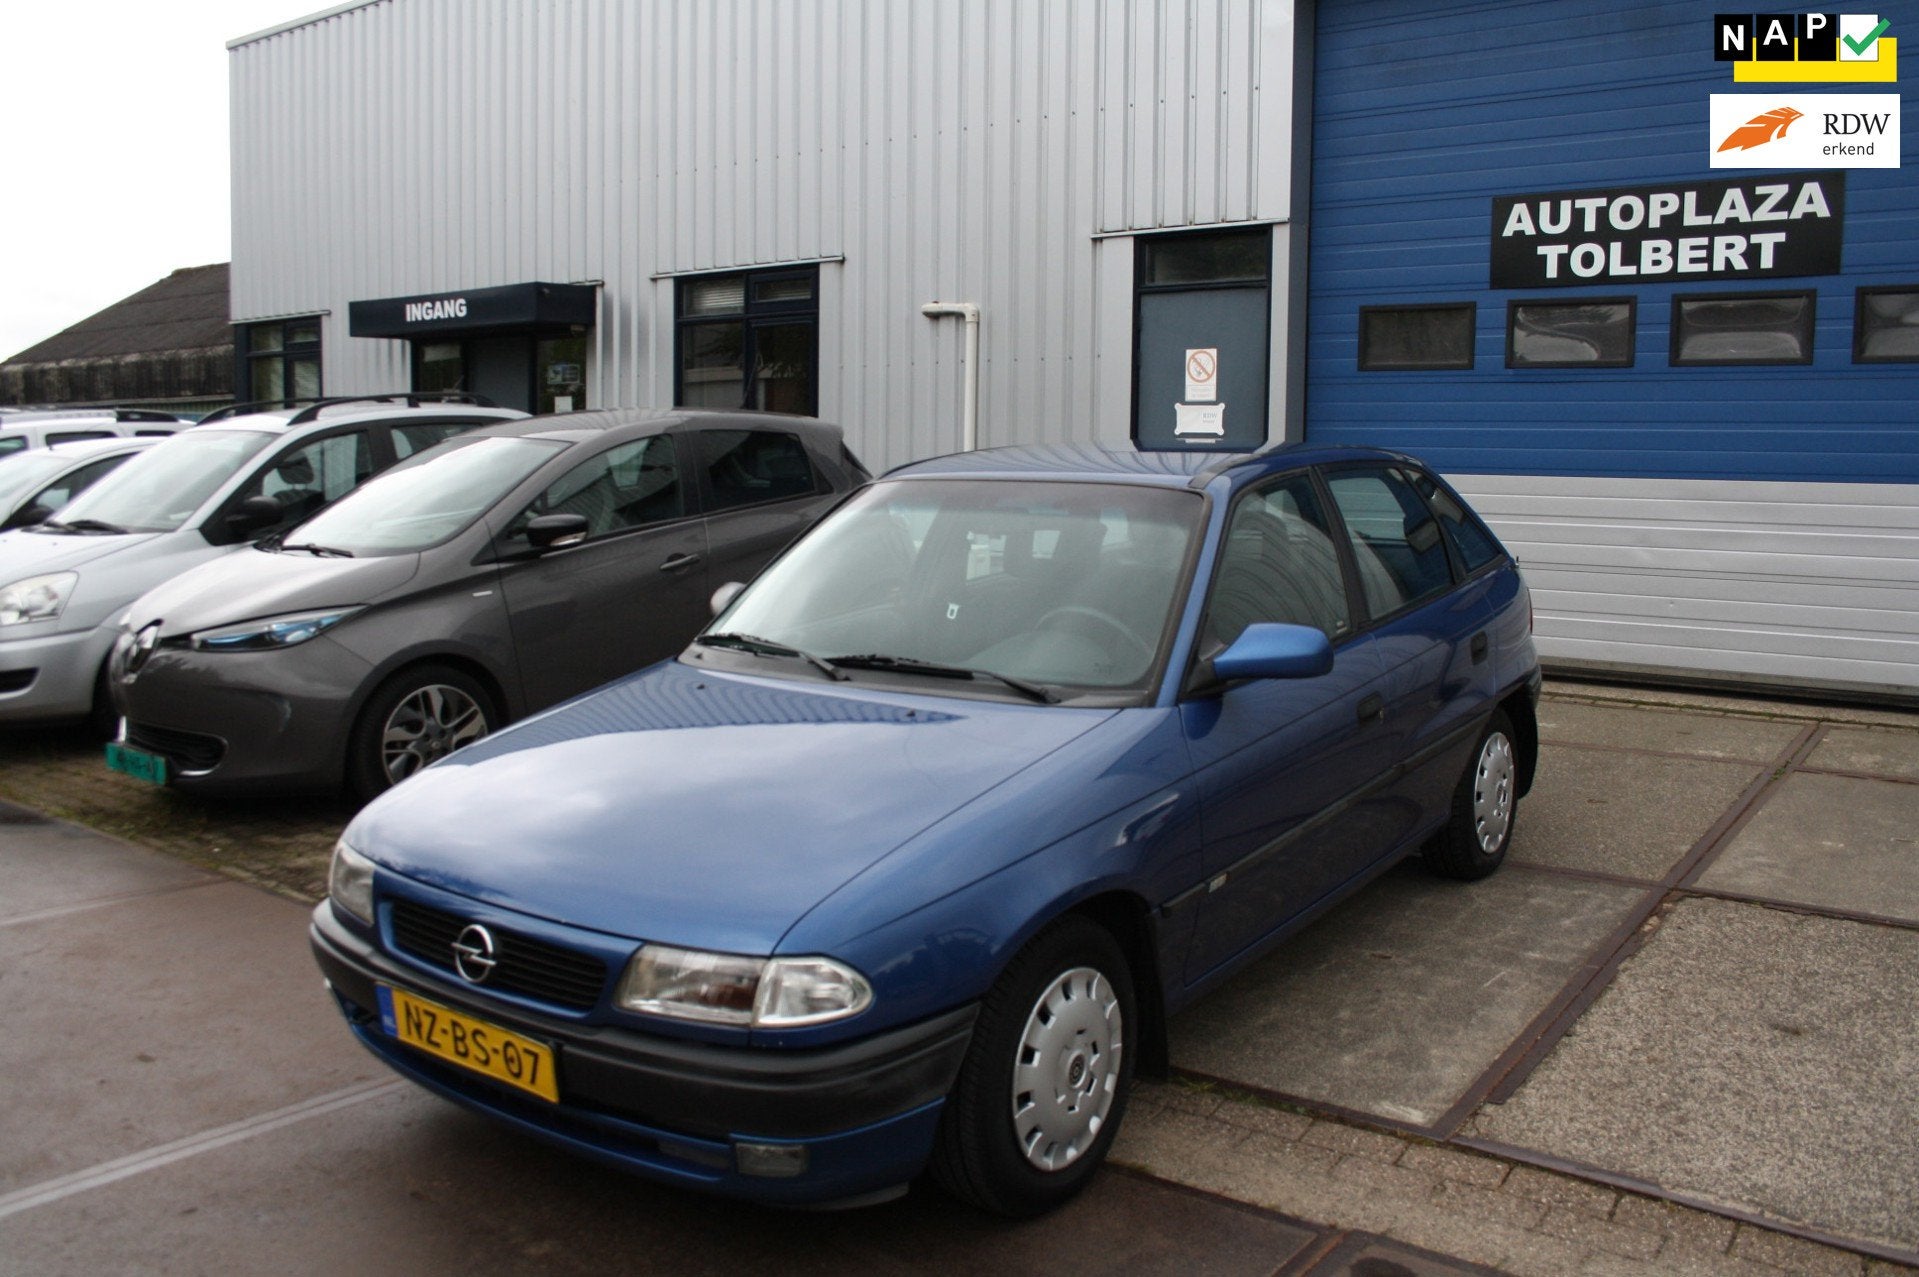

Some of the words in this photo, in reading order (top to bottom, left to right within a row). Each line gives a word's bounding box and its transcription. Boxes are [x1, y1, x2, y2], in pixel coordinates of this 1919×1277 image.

[1502, 181, 1832, 237] AUTOPLAZA
[1537, 232, 1787, 280] TOLBERT
[405, 298, 468, 322] INGANG
[404, 1000, 540, 1086] NZ-BS-07
